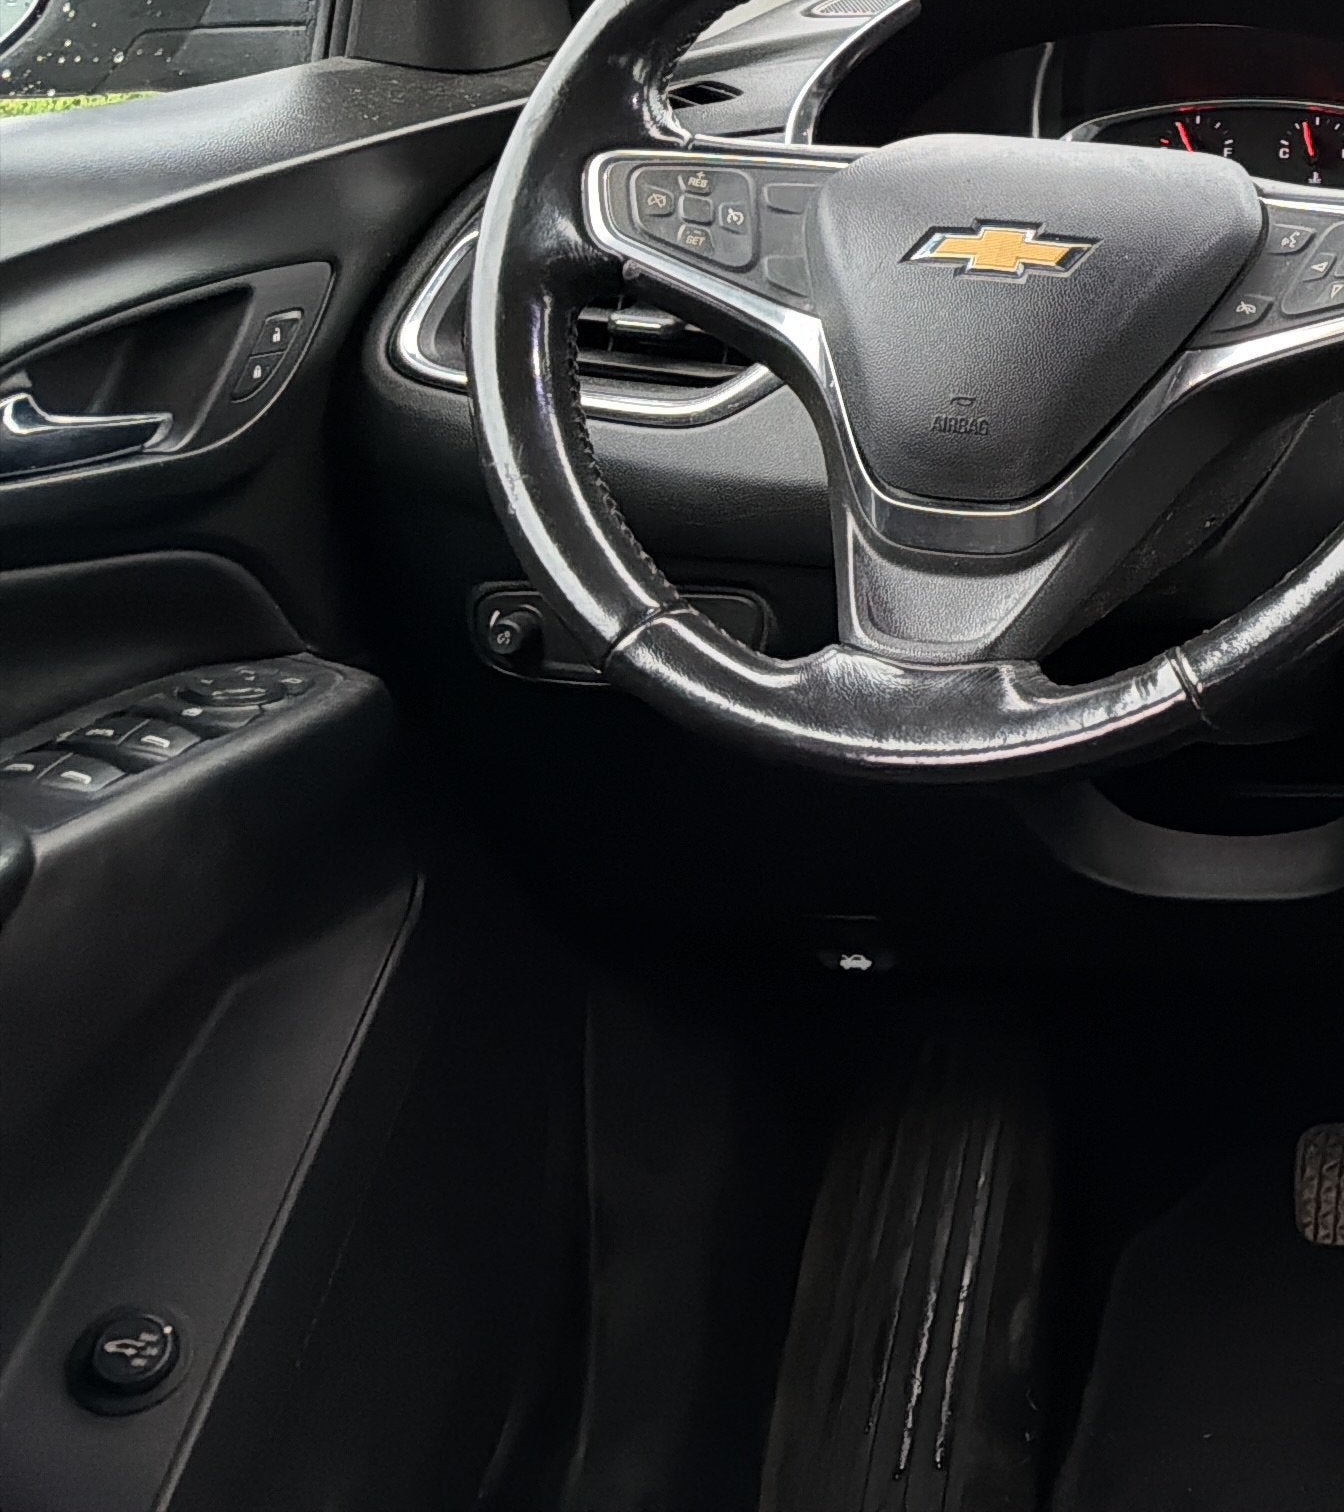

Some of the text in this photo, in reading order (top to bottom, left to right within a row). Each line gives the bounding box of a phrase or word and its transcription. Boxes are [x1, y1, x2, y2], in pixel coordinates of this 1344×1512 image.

[1223, 147, 1234, 159] F
[1278, 147, 1290, 159] C
[930, 416, 990, 436] AIRBAG
